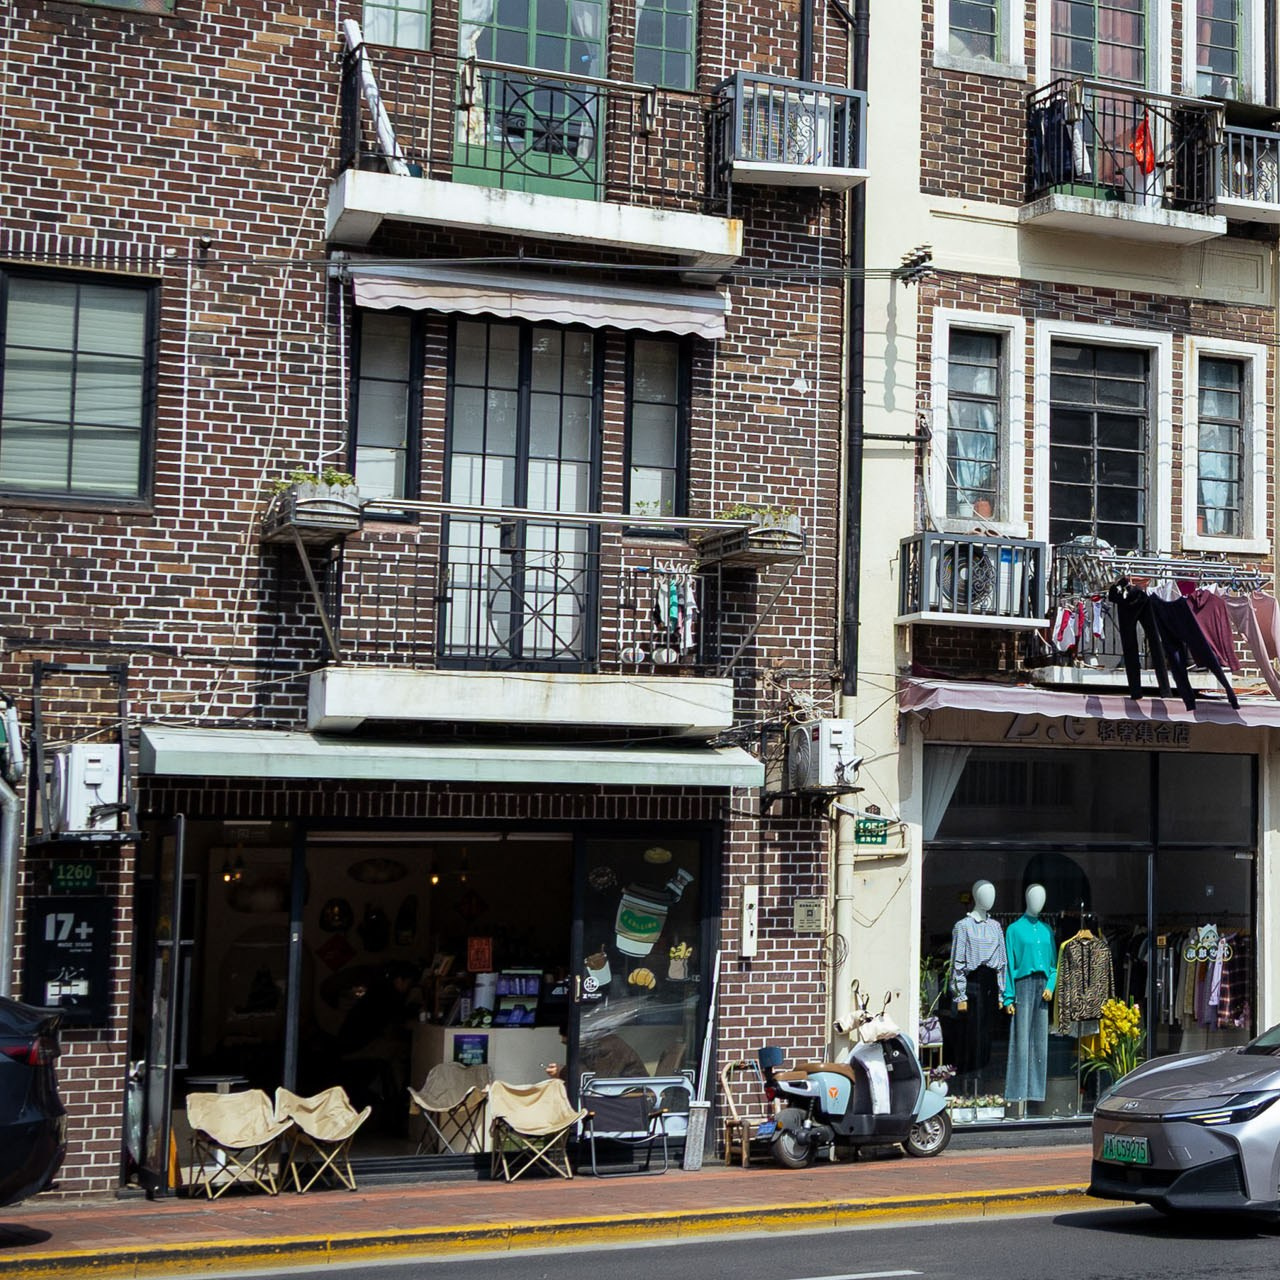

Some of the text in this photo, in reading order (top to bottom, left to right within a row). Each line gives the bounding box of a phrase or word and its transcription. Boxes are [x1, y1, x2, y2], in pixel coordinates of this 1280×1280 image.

[1098, 720, 1190, 745] 轻奢集合店
[57, 864, 93, 880] 1260
[45, 913, 93, 941] 17+
